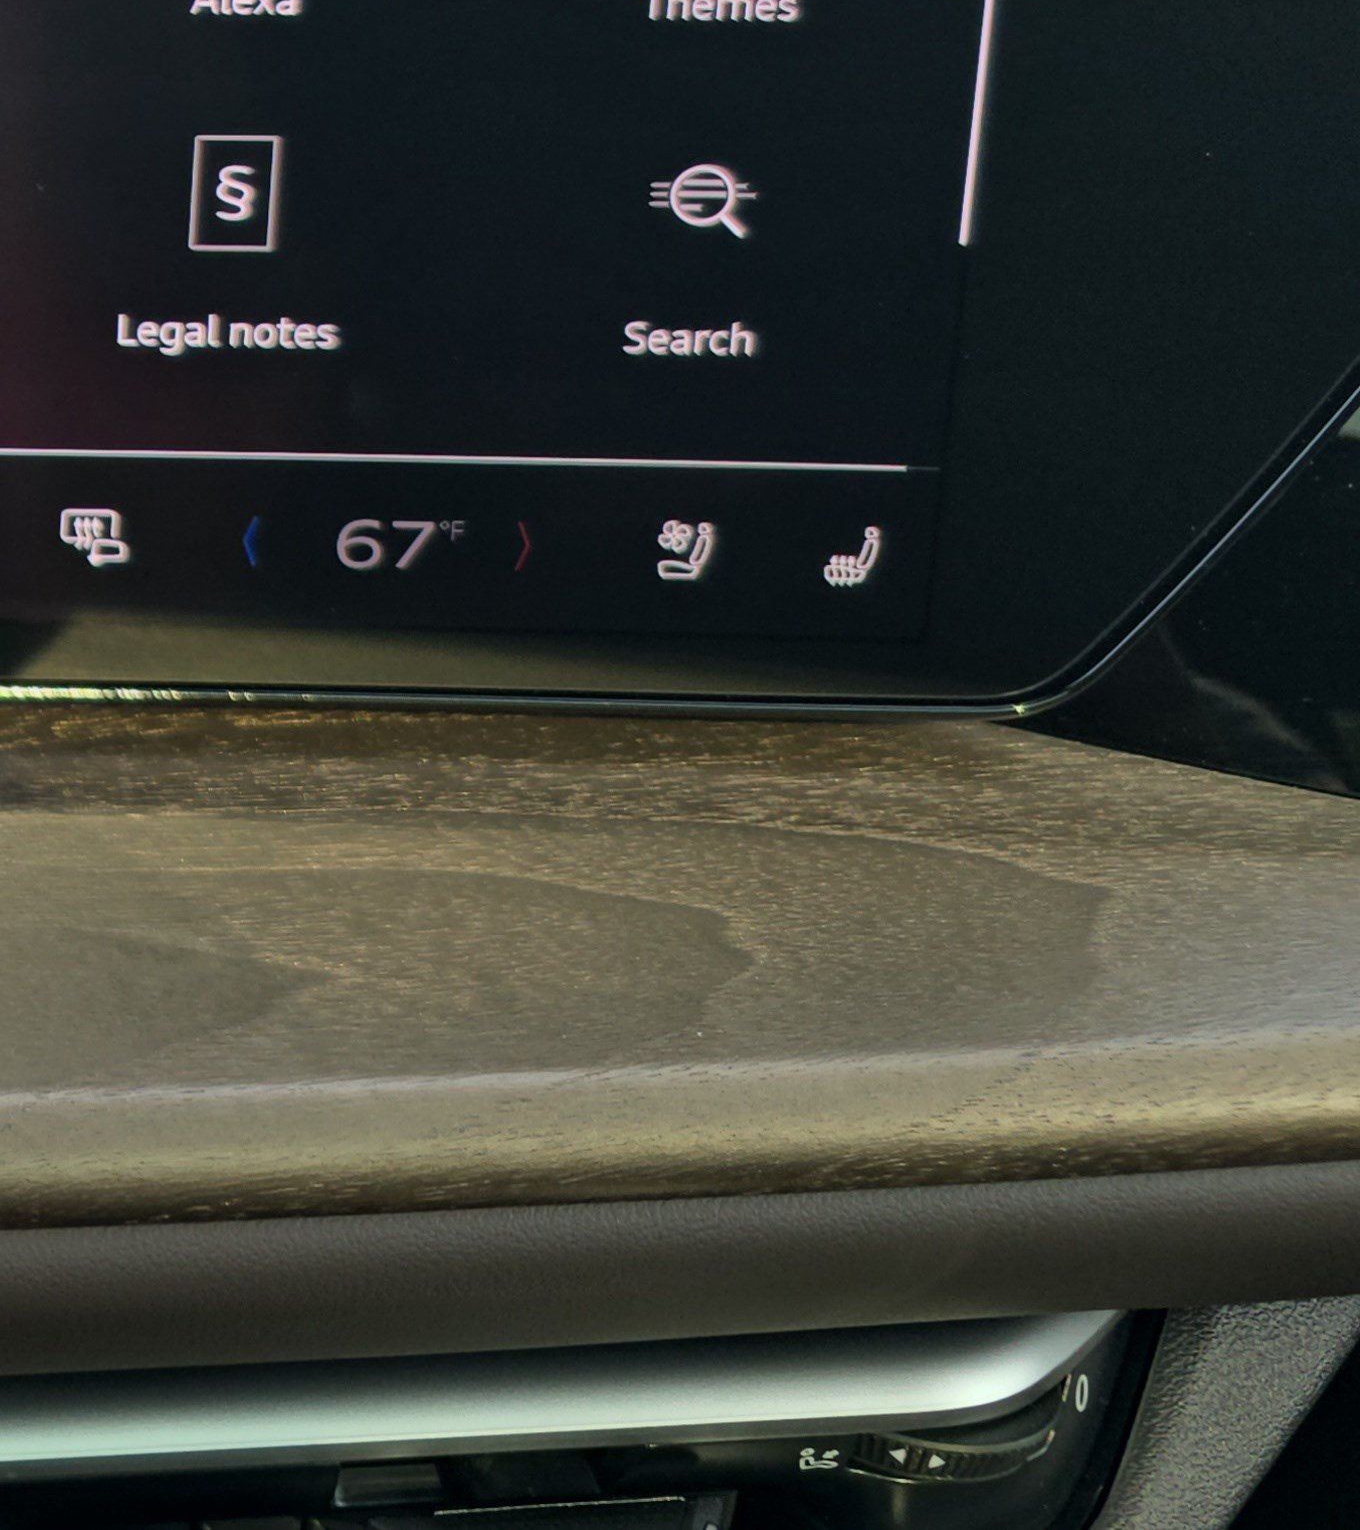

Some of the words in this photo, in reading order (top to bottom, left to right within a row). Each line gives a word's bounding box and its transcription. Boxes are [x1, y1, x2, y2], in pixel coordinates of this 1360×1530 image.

[116, 313, 222, 357] Legal
[228, 316, 341, 351] notes
[622, 320, 756, 357] Search
